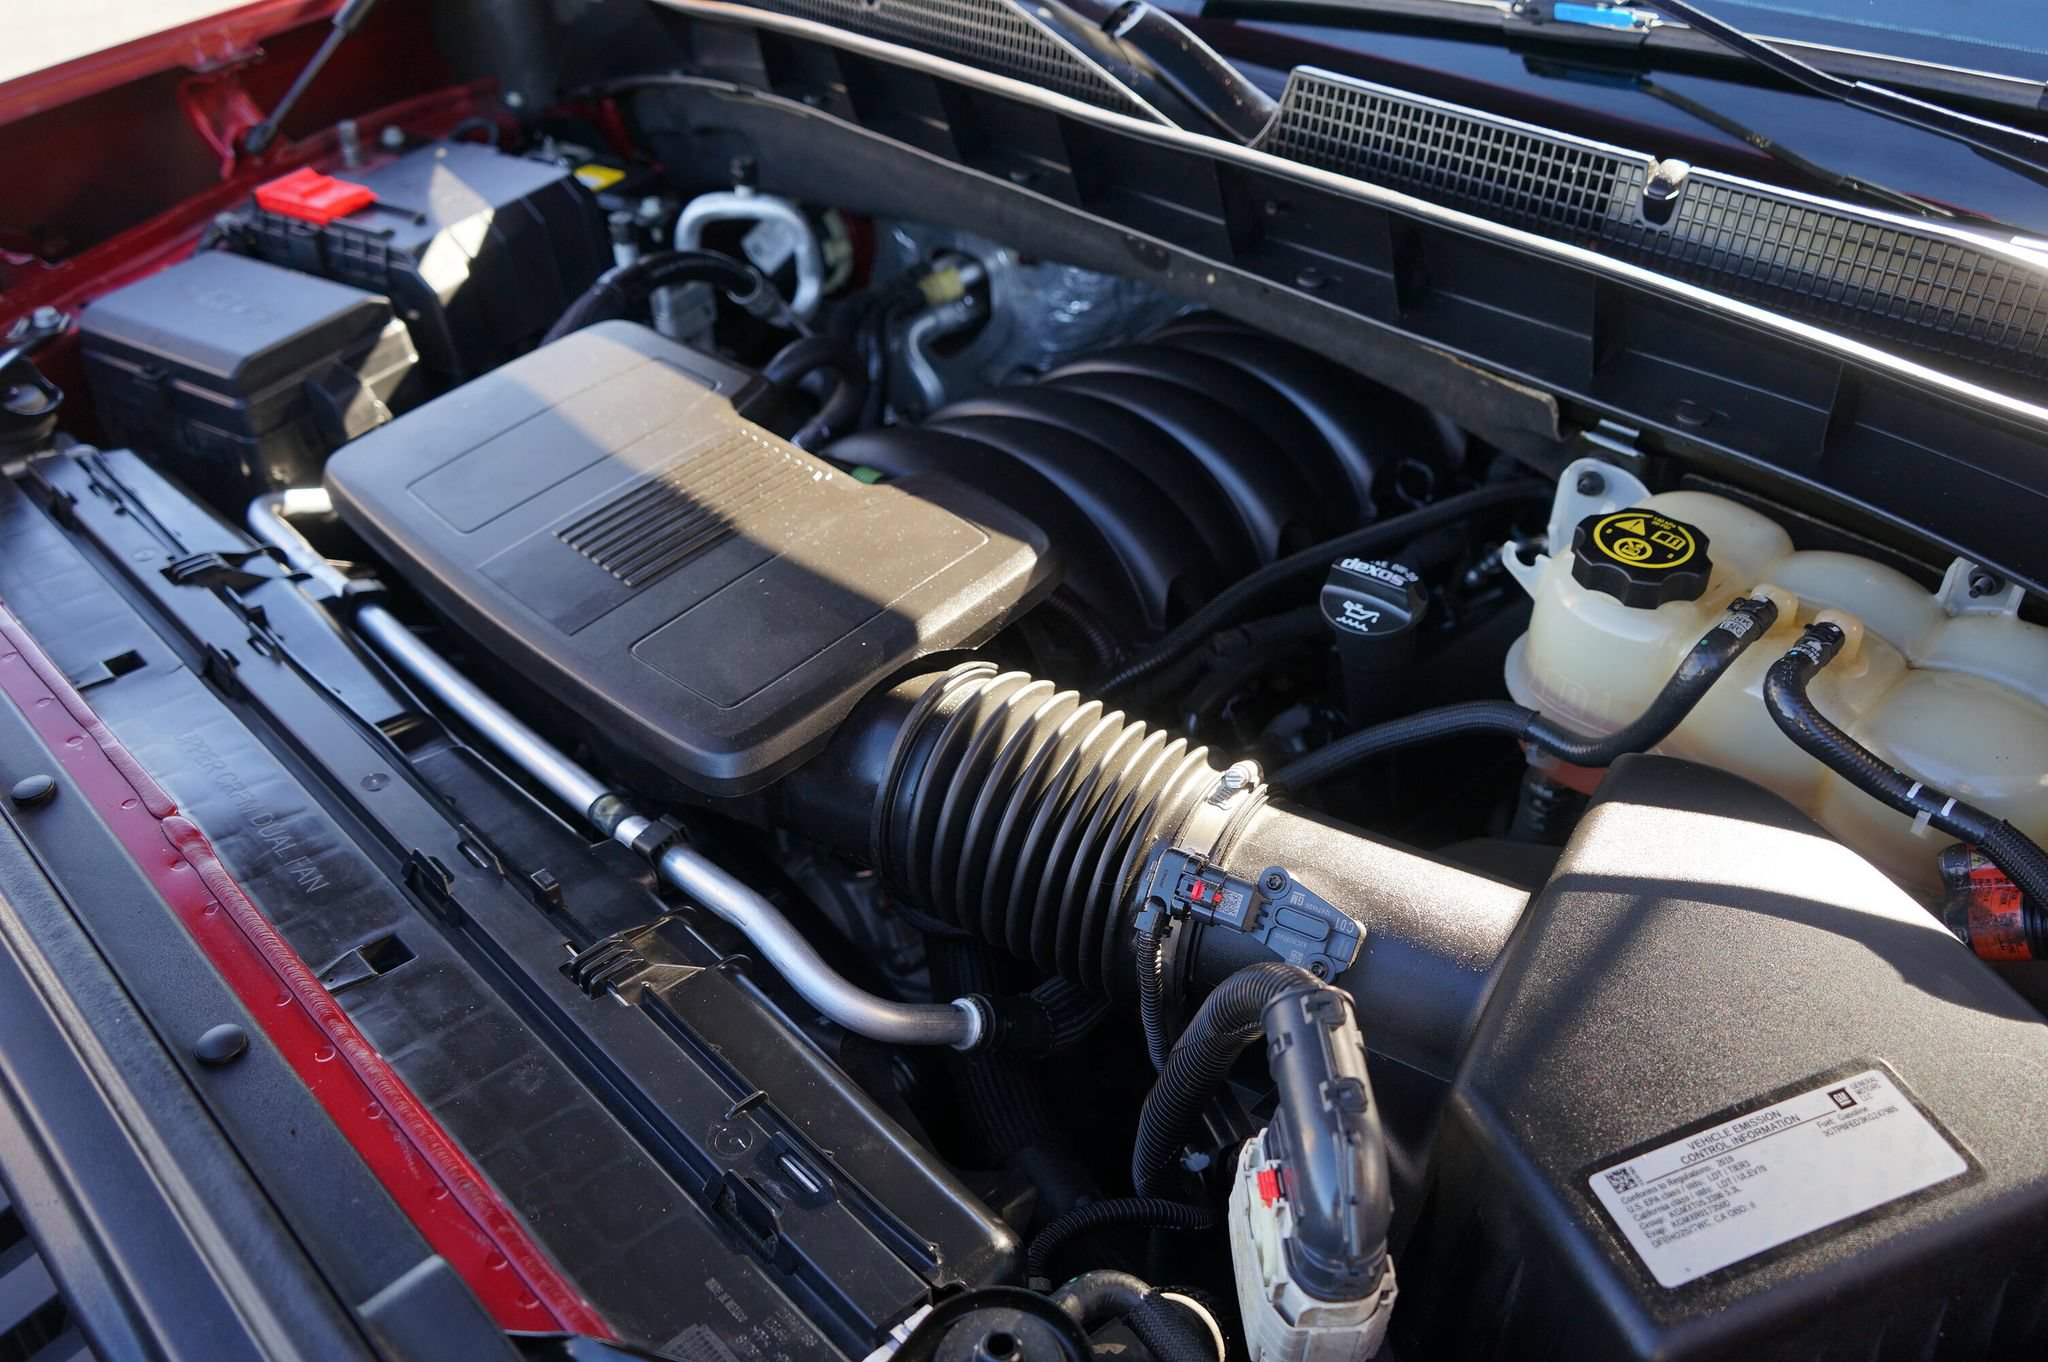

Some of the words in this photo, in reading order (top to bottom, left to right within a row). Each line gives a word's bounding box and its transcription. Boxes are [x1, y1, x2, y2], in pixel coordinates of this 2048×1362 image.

[1341, 558, 1408, 586] dexos
[1370, 560, 1388, 568] AE
[248, 812, 297, 859] DUAL
[284, 855, 331, 894] FAN
[1290, 893, 1305, 907] GM
[1335, 917, 1354, 934] C01
[1848, 1075, 1878, 1090] GENERAL
[1854, 1082, 1882, 1096] MOTORS
[1858, 1092, 1874, 1101] LLC
[1815, 1116, 1837, 1129] Fuel:
[1835, 1104, 1869, 1121] Gasoline
[1686, 1128, 1732, 1150] VEHICLE
[1730, 1108, 1782, 1133] EMISSION
[1679, 1139, 1732, 1165] CONTROL
[1729, 1113, 1801, 1146] INFORMATION
[1619, 1184, 1659, 1205] Conforms
[1656, 1181, 1667, 1190] to
[1665, 1163, 1714, 1187] Regulations:
[1714, 1154, 1735, 1167] 2019
[1642, 1194, 1661, 1206] EPA
[1659, 1186, 1681, 1199] class
[1705, 1170, 1722, 1181] LDT
[1631, 1201, 1671, 1222] California
[1668, 1194, 1691, 1207] class
[1715, 1178, 1732, 1189] LDT
[1637, 1214, 1667, 1231] Group:
[1712, 1212, 1727, 1222] CA
[1643, 1225, 1667, 1239] Evap:
